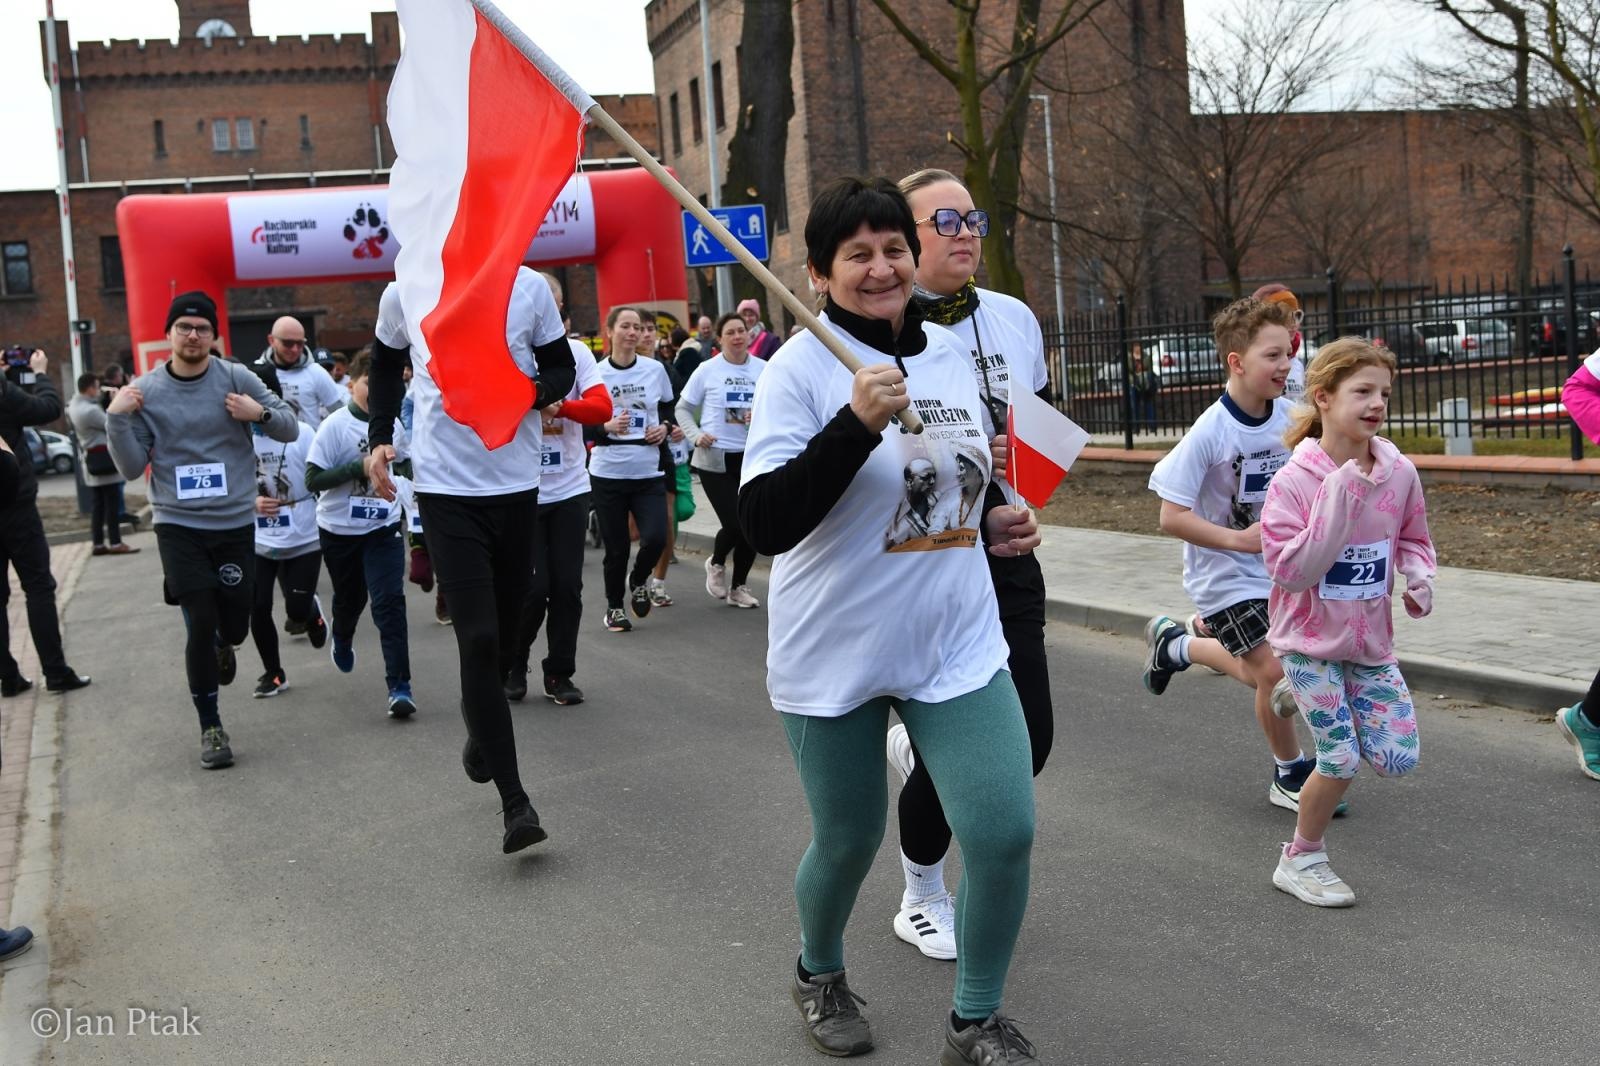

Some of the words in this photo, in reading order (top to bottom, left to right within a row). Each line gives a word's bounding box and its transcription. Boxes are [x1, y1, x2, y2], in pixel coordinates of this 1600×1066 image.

[264, 220, 317, 231] Raciborskie
[267, 244, 299, 255] Kultury
[738, 393, 745, 402] 4
[914, 400, 943, 409] TROPEM
[918, 408, 972, 424] WILCZYM
[193, 476, 212, 489] 76
[364, 508, 379, 519] 12
[267, 517, 281, 527] 92
[1351, 563, 1376, 584] 22
